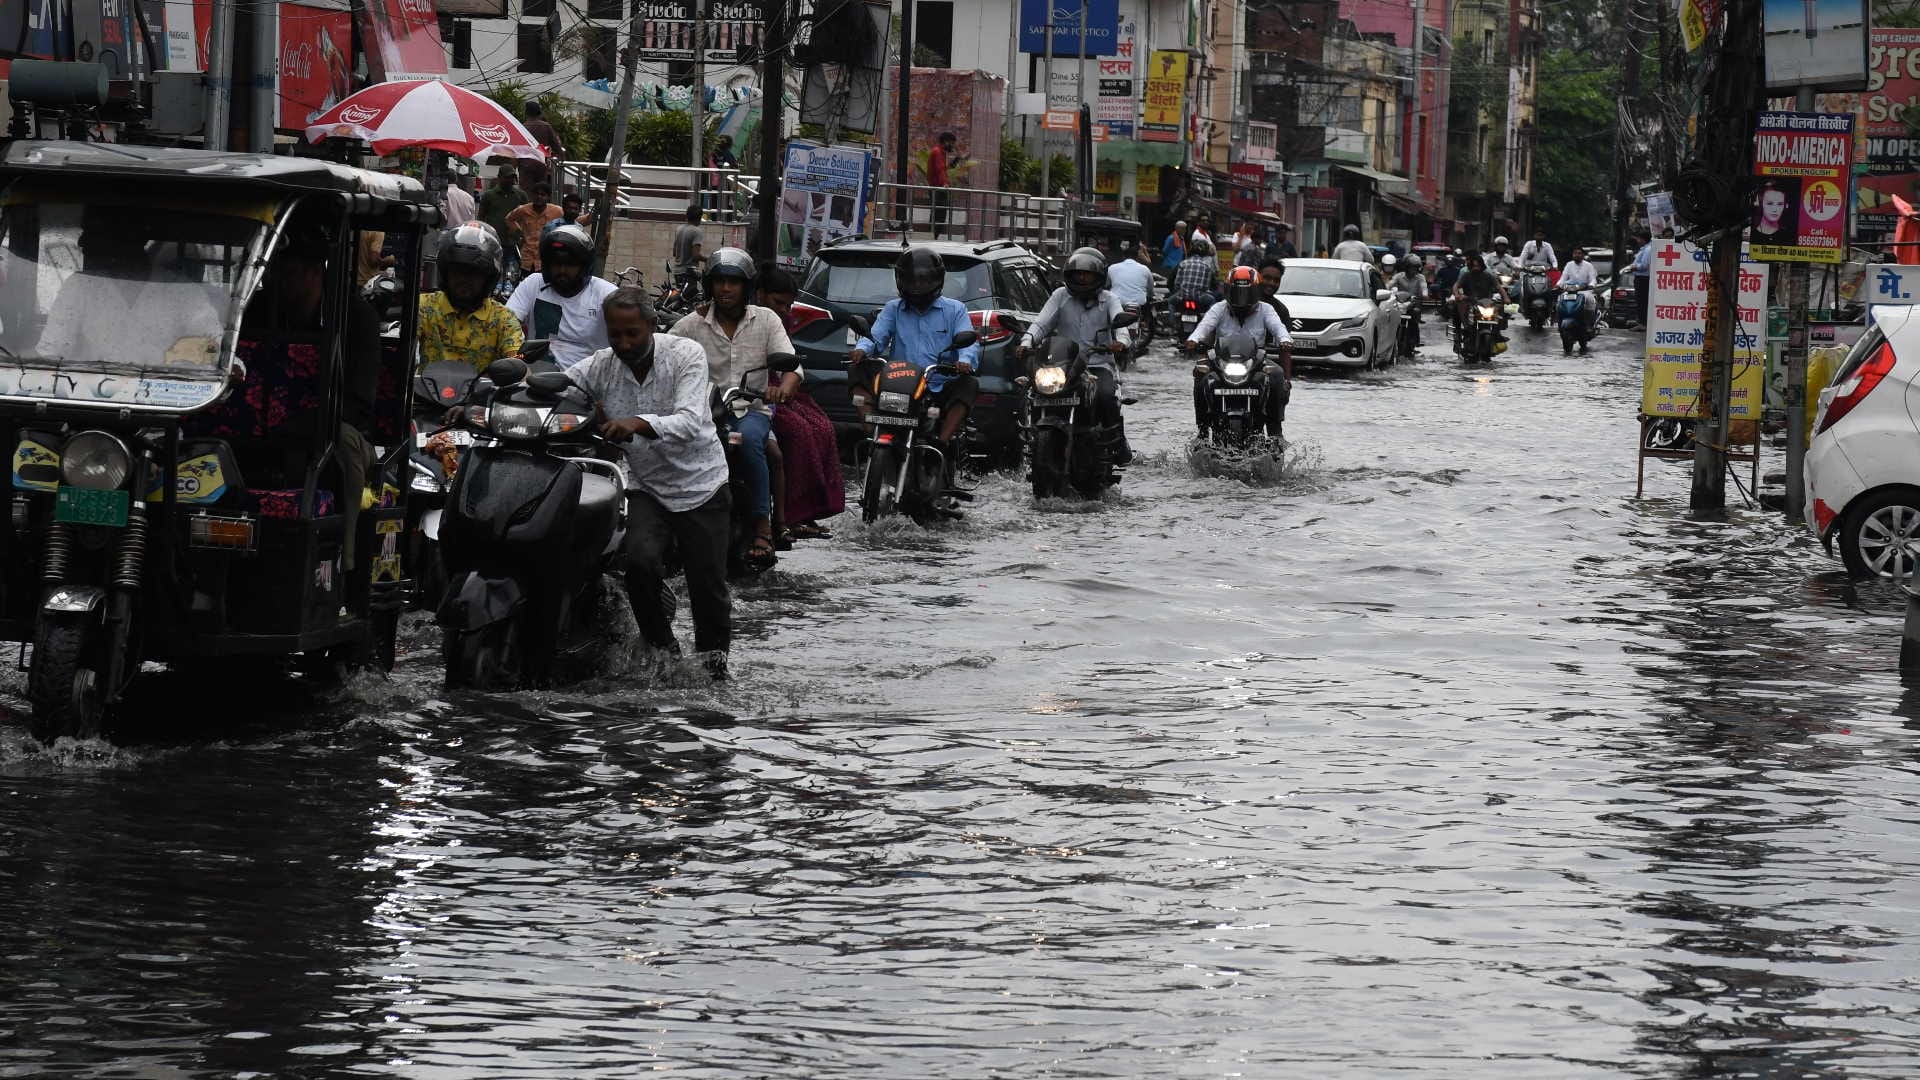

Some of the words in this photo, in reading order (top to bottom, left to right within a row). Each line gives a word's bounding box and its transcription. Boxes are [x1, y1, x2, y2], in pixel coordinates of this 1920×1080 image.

[1656, 270, 1695, 291] समस्त
[1656, 302, 1698, 321] दवाओं
[1655, 331, 1687, 345] अजय
